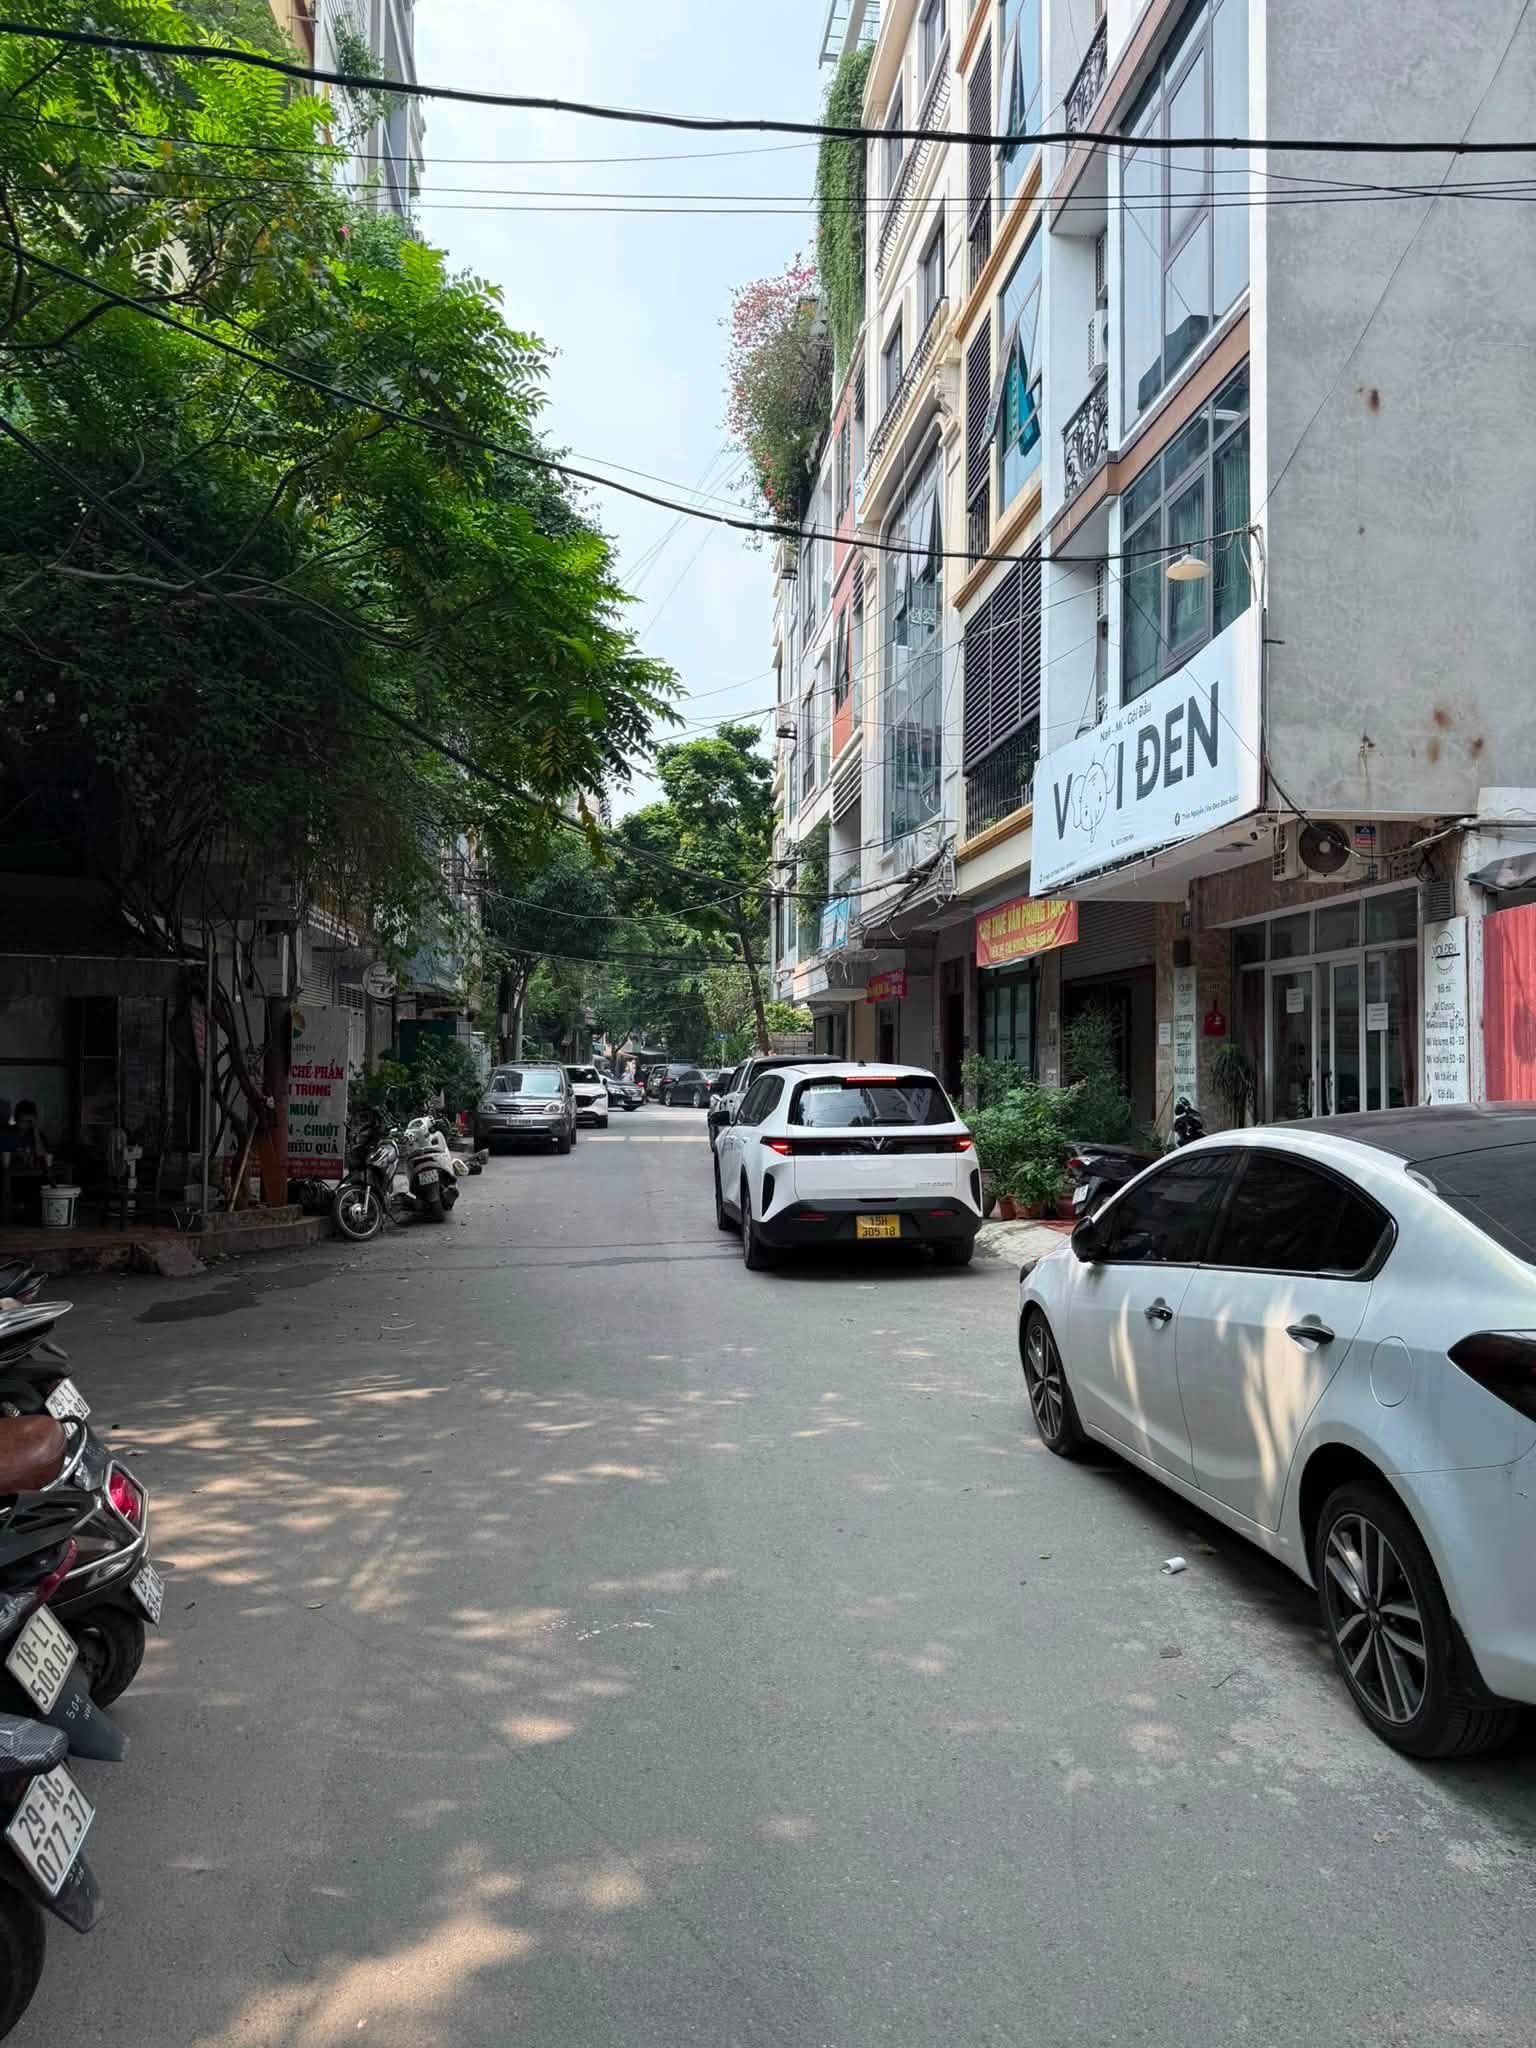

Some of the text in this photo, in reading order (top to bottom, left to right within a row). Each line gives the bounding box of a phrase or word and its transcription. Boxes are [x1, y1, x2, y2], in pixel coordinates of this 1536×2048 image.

[1136, 681, 1219, 801] ĐEN
[15, 1613, 54, 1673] 18-L1
[30, 1633, 74, 1705] 508.04
[36, 1787, 88, 1886] 077.37
